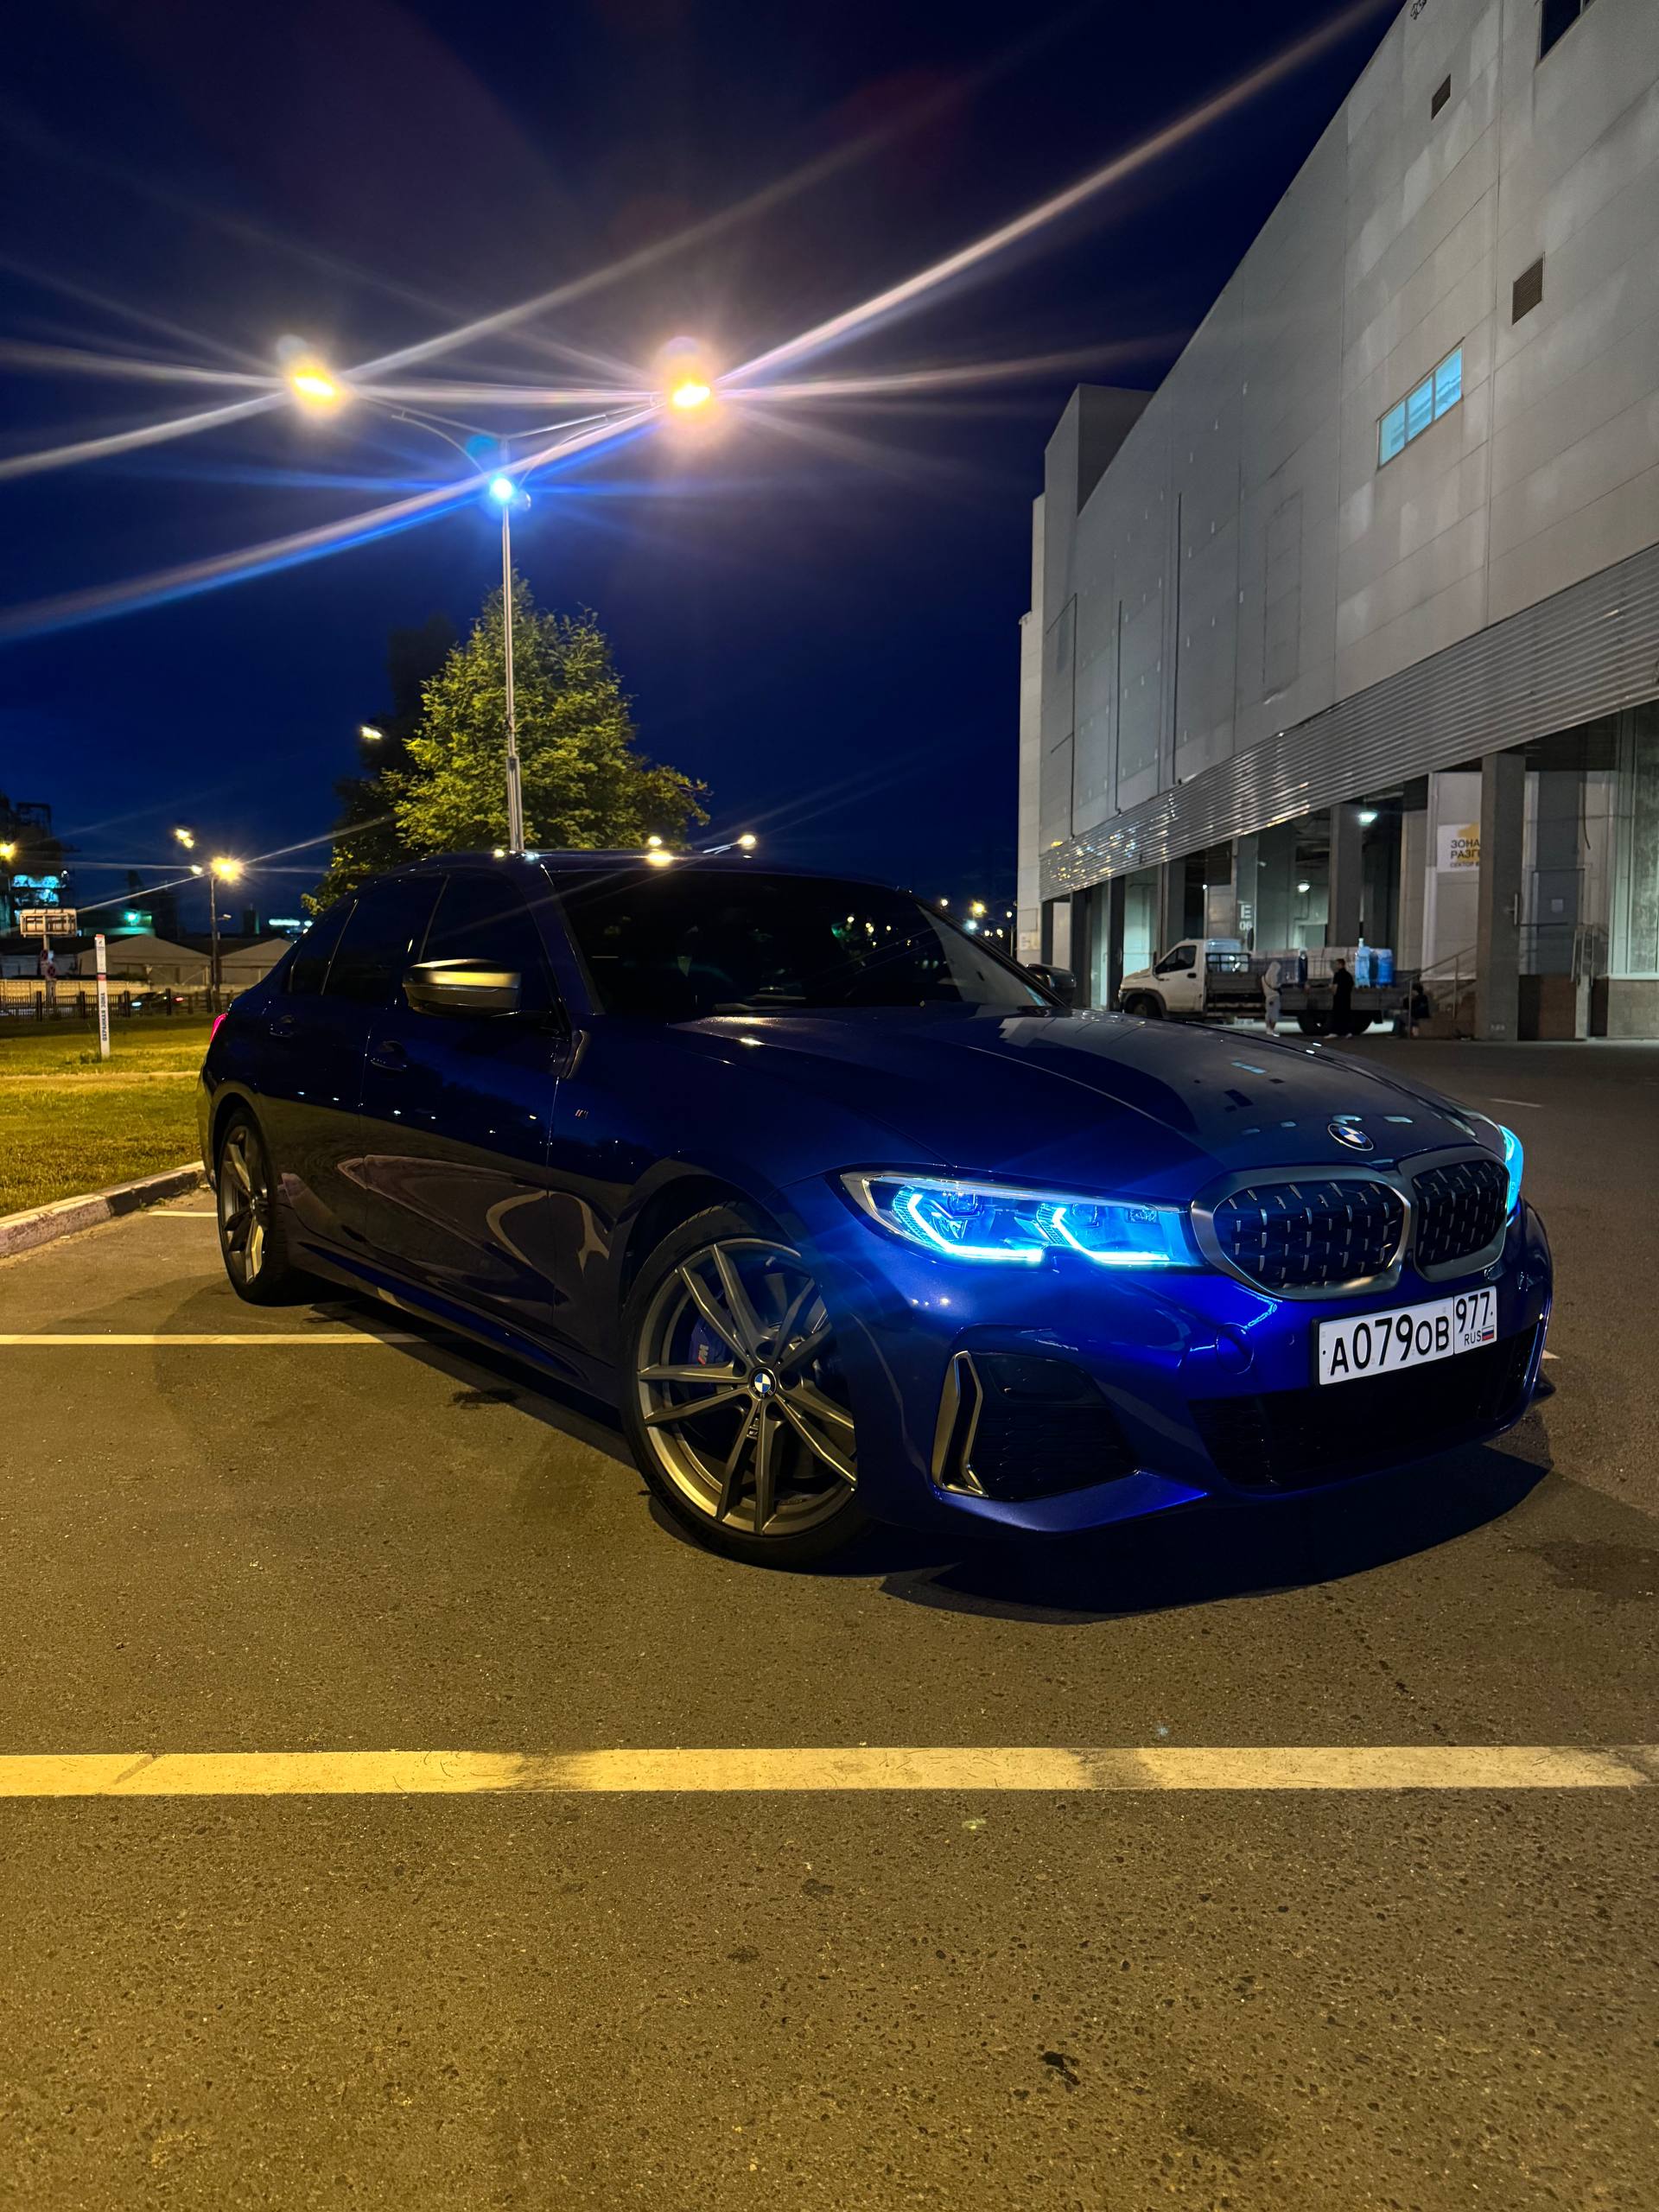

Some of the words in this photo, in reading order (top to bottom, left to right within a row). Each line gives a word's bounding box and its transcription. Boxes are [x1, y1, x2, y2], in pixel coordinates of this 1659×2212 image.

[1451, 838, 1480, 849] ЗОНА
[1451, 849, 1479, 859] РАЗГ
[1455, 1291, 1491, 1334] 977
[1464, 1332, 1482, 1346] RUS
